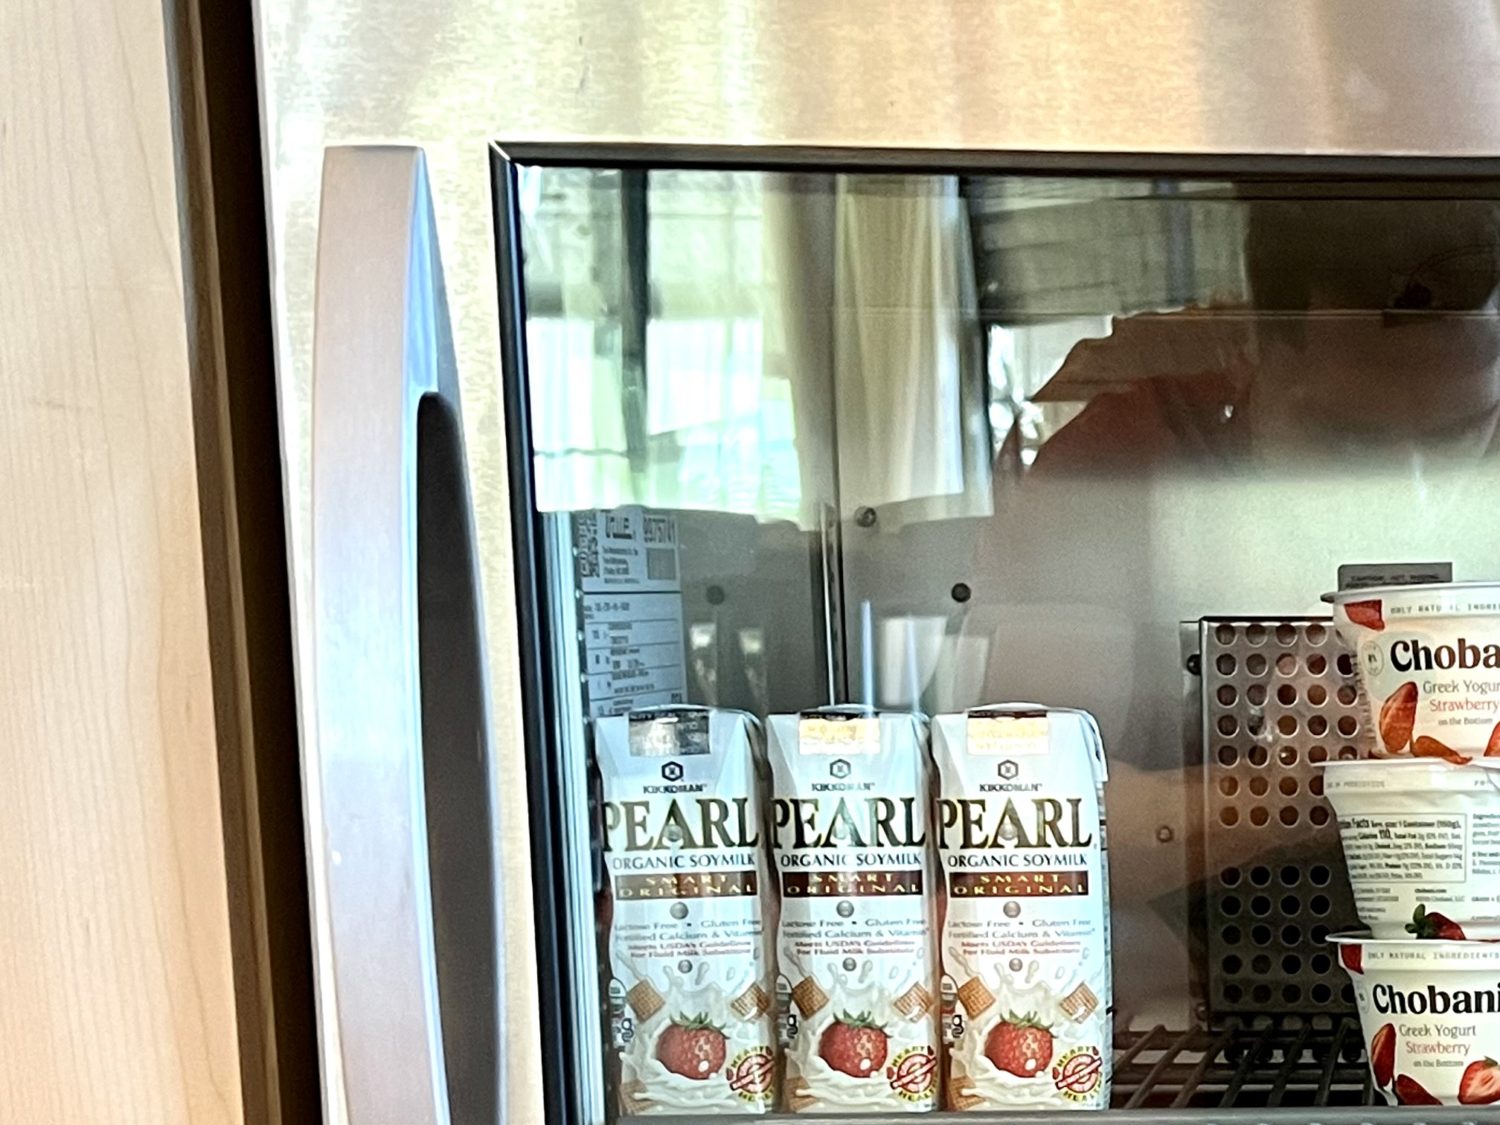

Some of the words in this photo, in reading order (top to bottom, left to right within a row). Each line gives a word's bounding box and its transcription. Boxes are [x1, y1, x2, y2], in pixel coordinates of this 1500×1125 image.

[1423, 680, 1459, 693] Greek
[1430, 699, 1499, 713] Strawberry
[601, 798, 759, 852] PEARL
[771, 797, 926, 849] PEARL
[937, 797, 1092, 849] PEARL
[613, 855, 685, 869] ORGANIC
[690, 853, 756, 867] SOYMILK
[781, 854, 848, 867] ORGANIC
[857, 853, 921, 865] SOYMILK
[948, 854, 1019, 867] ORGANIC
[1024, 854, 1087, 866] SOYMILK
[645, 876, 727, 885] SMART
[980, 874, 1060, 883] SMART
[619, 885, 755, 896] ORIGINAL
[954, 885, 1086, 894] ORIGINAL
[1400, 1024, 1431, 1037] Greek
[1435, 1025, 1476, 1038] Yogurt
[1406, 1042, 1470, 1055] Strawberry
